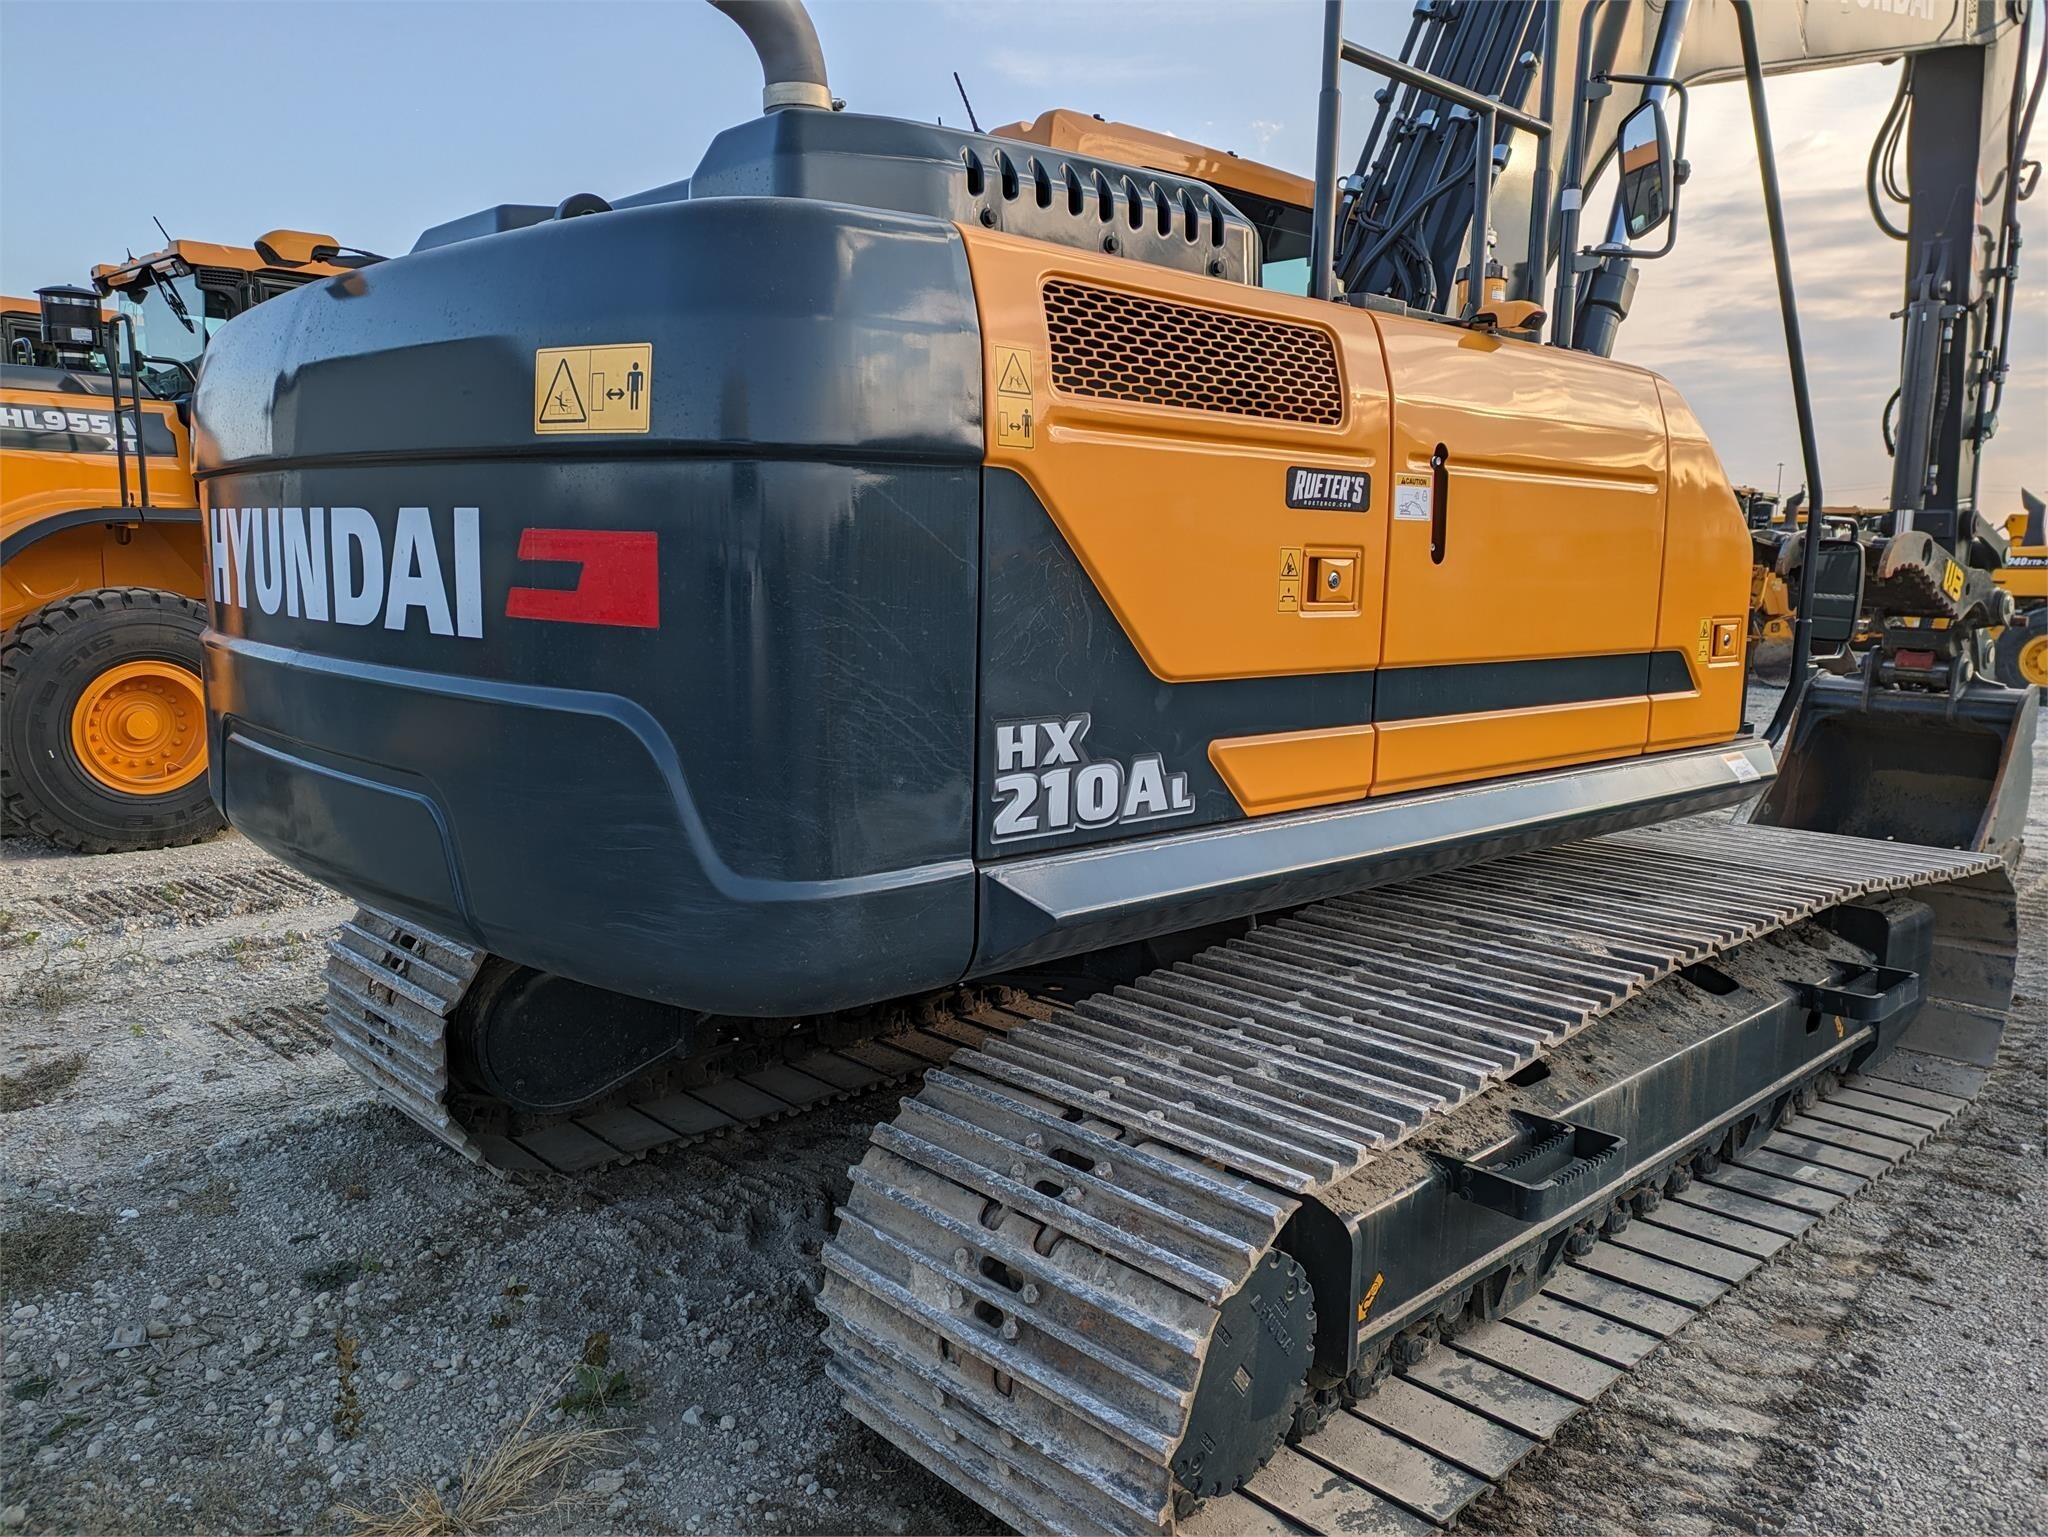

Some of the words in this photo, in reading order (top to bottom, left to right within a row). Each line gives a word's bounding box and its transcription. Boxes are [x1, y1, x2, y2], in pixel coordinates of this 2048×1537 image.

[1292, 470, 1365, 504] RUETER'S
[1406, 477, 1428, 486] CAUTION
[210, 507, 483, 638] HYUNDAI
[996, 718, 1084, 771] HX
